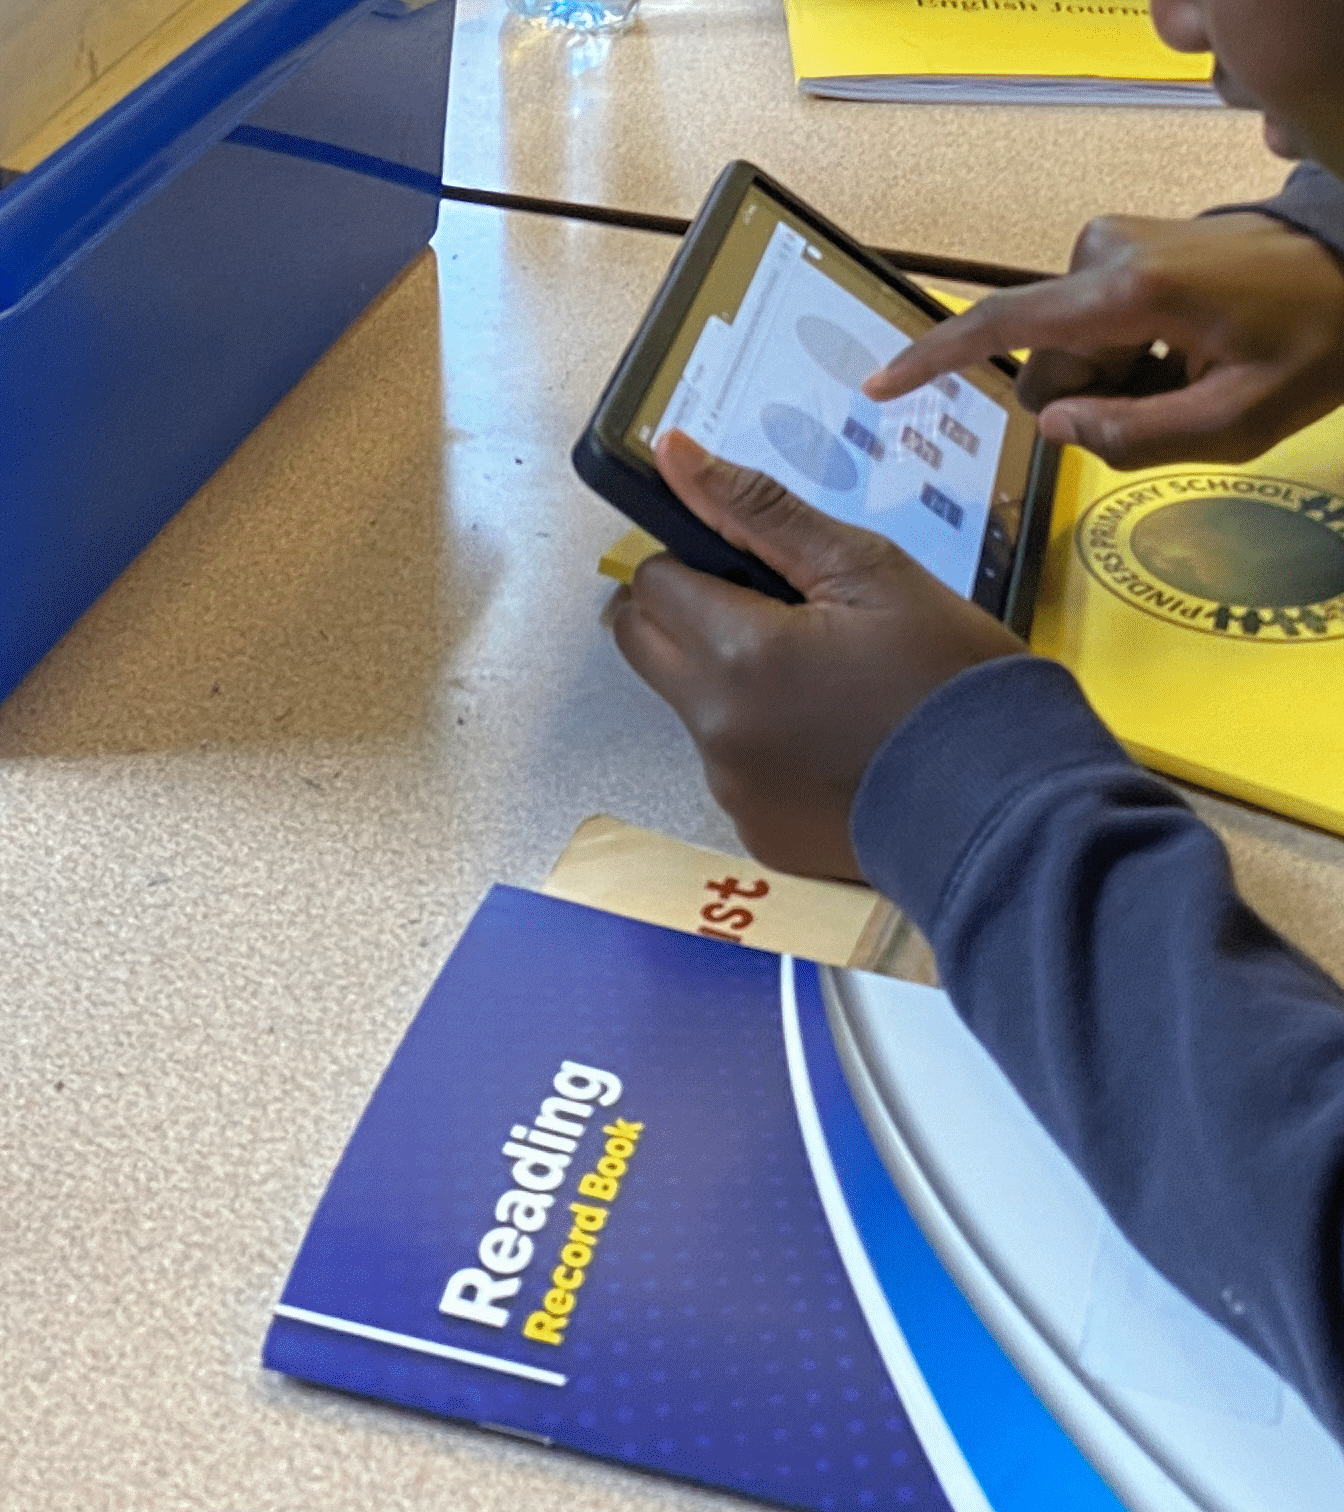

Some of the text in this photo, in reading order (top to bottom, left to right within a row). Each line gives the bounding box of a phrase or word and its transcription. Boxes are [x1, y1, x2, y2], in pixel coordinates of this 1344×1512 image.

[1089, 477, 1301, 621] PINDERS PRIMARY SCHOOL
[438, 1059, 623, 1328] Reading
[523, 1118, 645, 1346] Record Book
